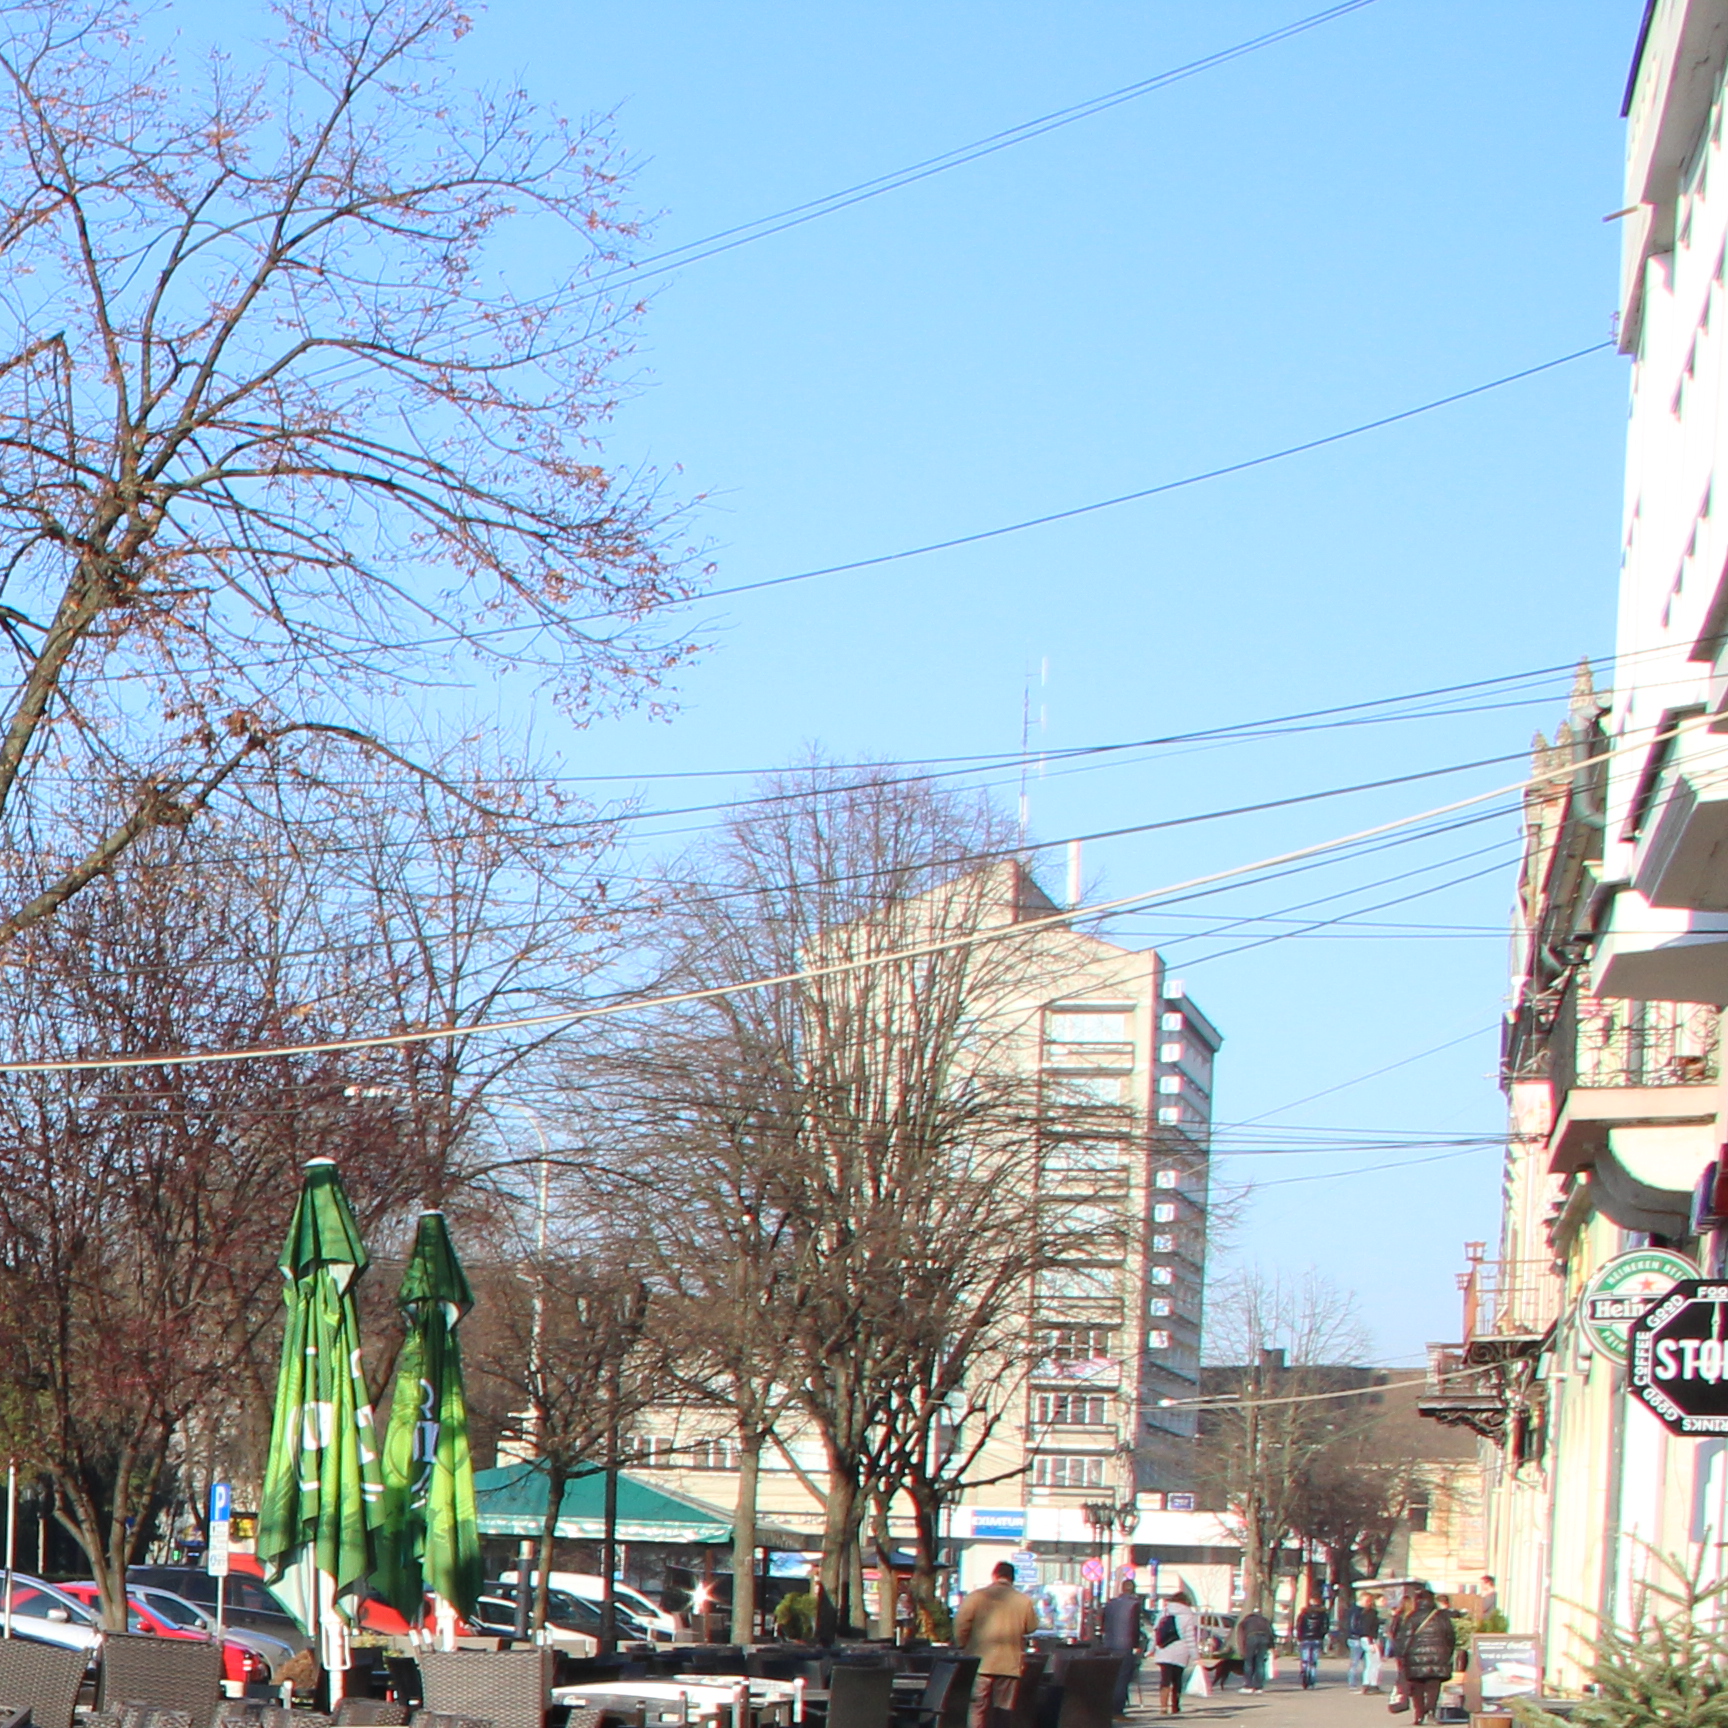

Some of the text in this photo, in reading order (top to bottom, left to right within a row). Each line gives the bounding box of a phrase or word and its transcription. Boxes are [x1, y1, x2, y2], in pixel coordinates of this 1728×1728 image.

[1606, 1260, 1662, 1285] HEINEKEN
[1594, 1296, 1654, 1319] Hein
[1645, 1294, 1685, 1328] GOOD
[1633, 1331, 1679, 1422] GOOD COFFEE
[1654, 1338, 1728, 1381] STO
[214, 1485, 226, 1520] P
